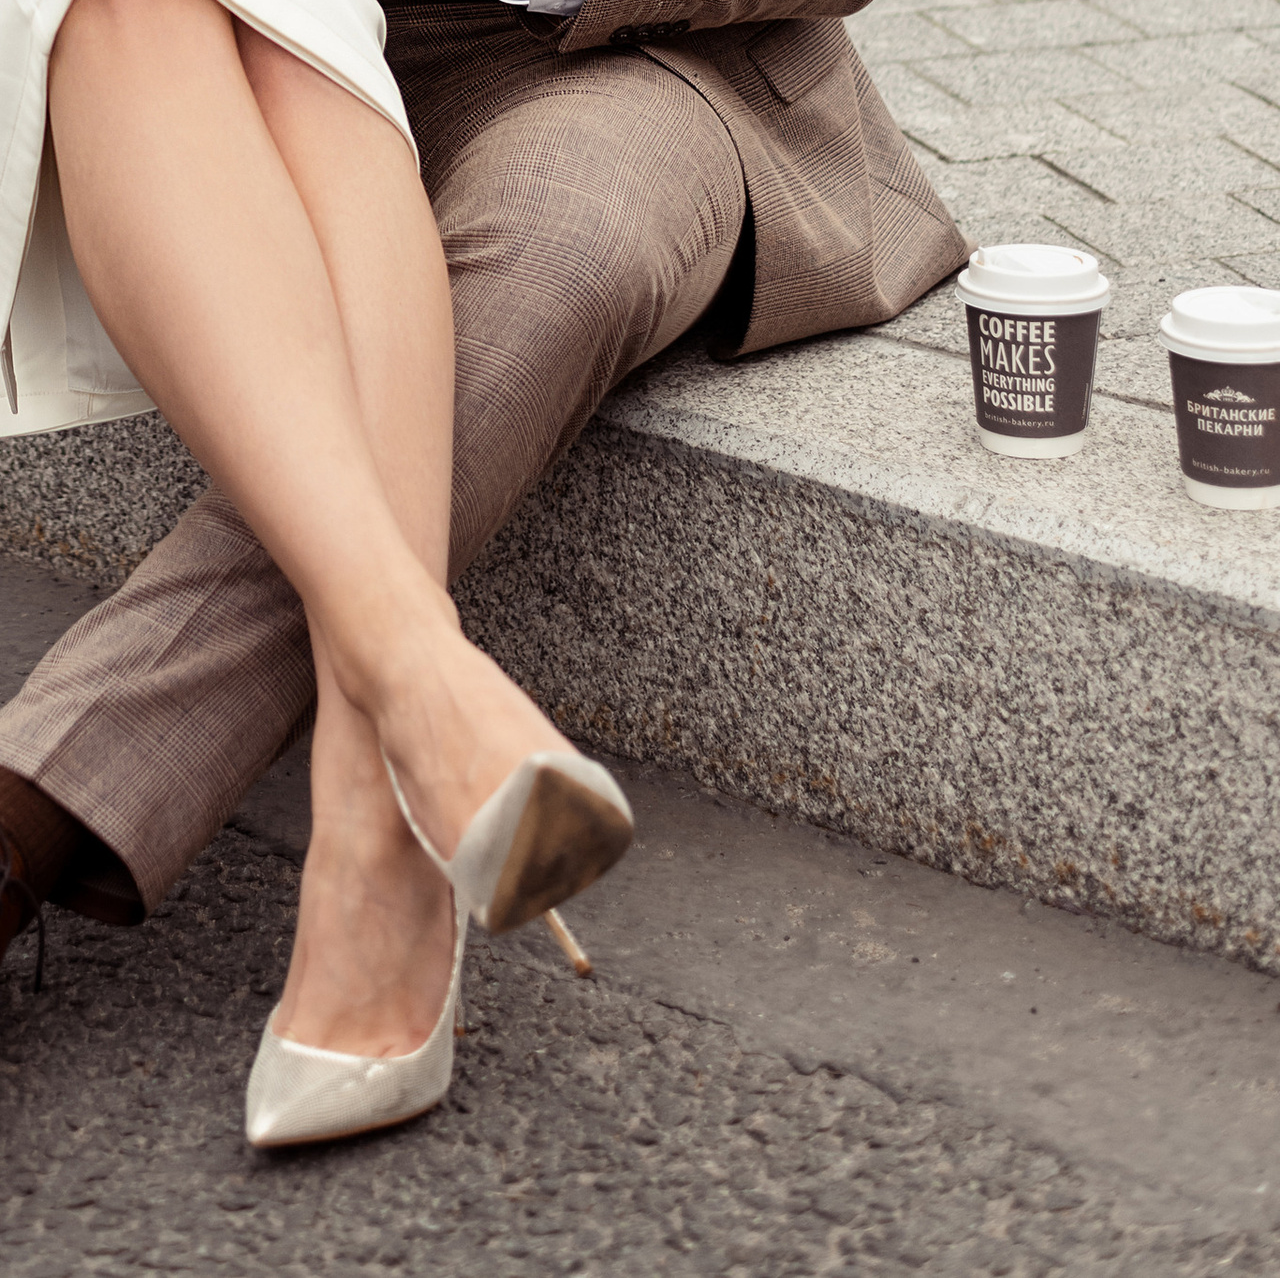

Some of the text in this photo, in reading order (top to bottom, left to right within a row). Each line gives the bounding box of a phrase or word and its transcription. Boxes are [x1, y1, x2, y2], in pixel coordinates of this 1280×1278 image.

[979, 313, 1056, 343] COFFEE
[980, 336, 1057, 375] MAKES
[982, 369, 1055, 392] EVERYTHING
[983, 386, 1054, 412] POSSIBLE
[984, 411, 1055, 428] british-bakery.ru
[1187, 400, 1276, 422] БРИТАНСКИЕ
[1197, 418, 1264, 437] ПЕКАРНИ
[1192, 457, 1270, 477] british-bakery.ru
